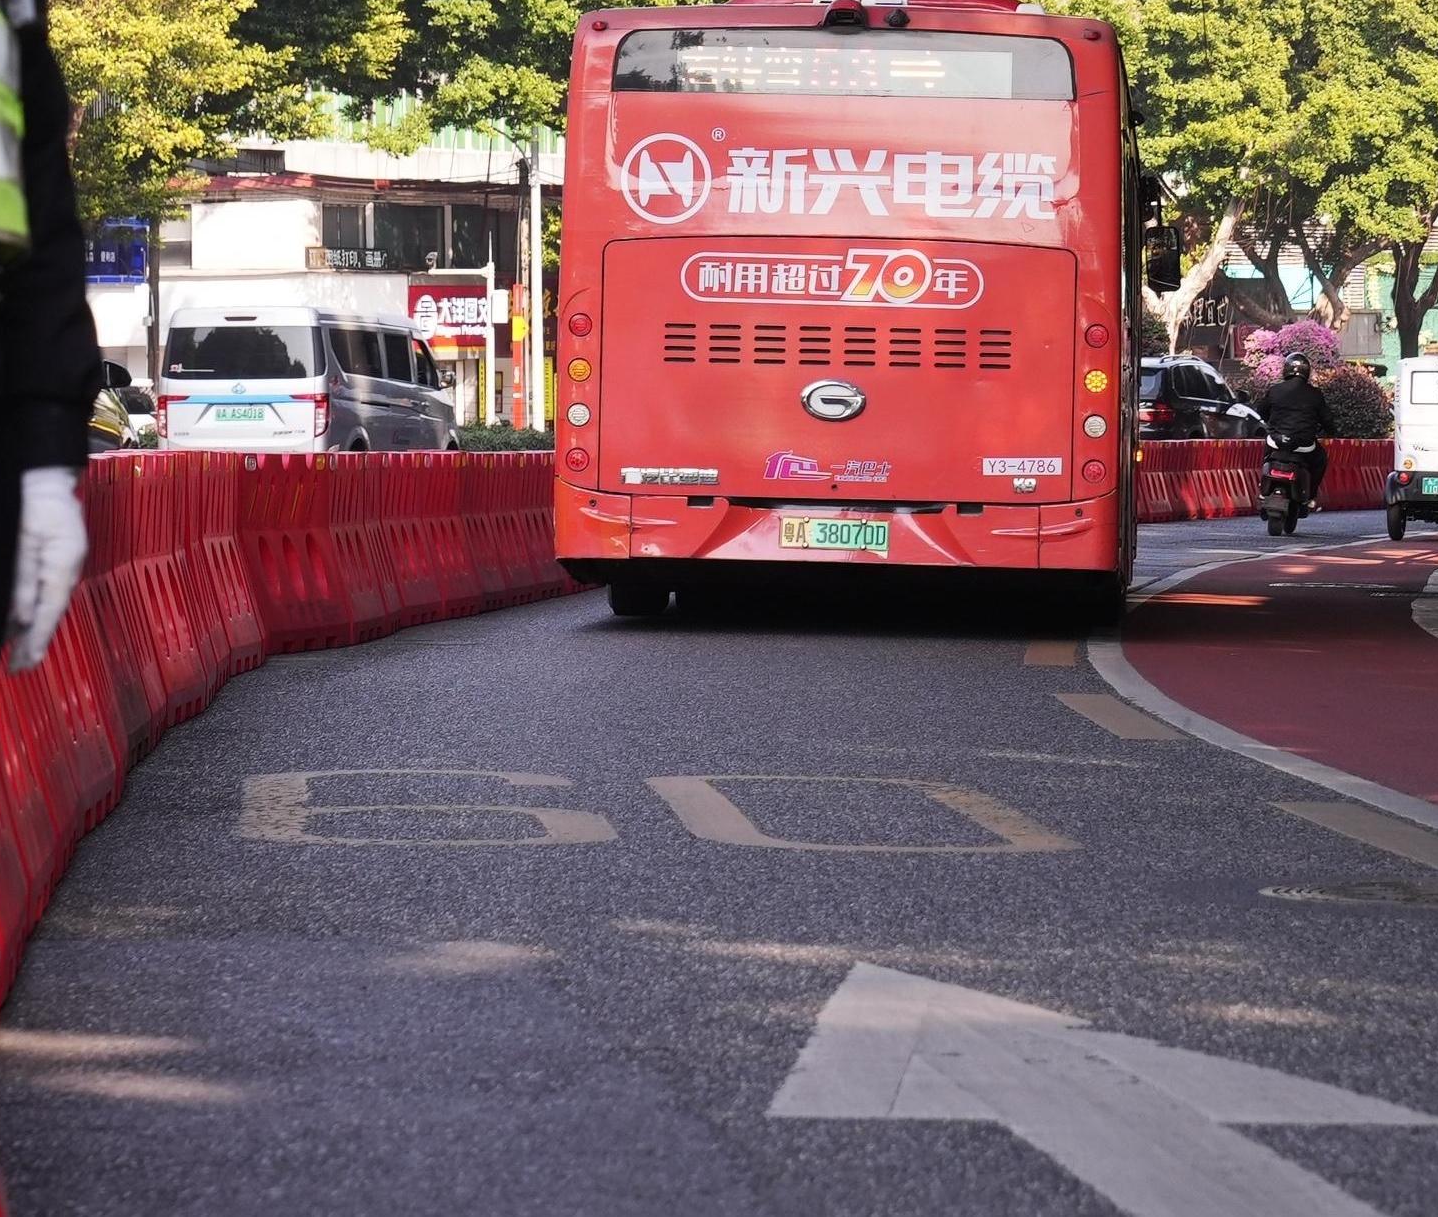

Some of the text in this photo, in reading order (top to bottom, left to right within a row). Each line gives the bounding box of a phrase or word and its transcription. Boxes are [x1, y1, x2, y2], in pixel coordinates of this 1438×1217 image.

[726, 147, 1057, 220] 新兴电缆
[697, 248, 970, 304] 耐用超过70年
[987, 460, 1055, 473] Y3-4786
